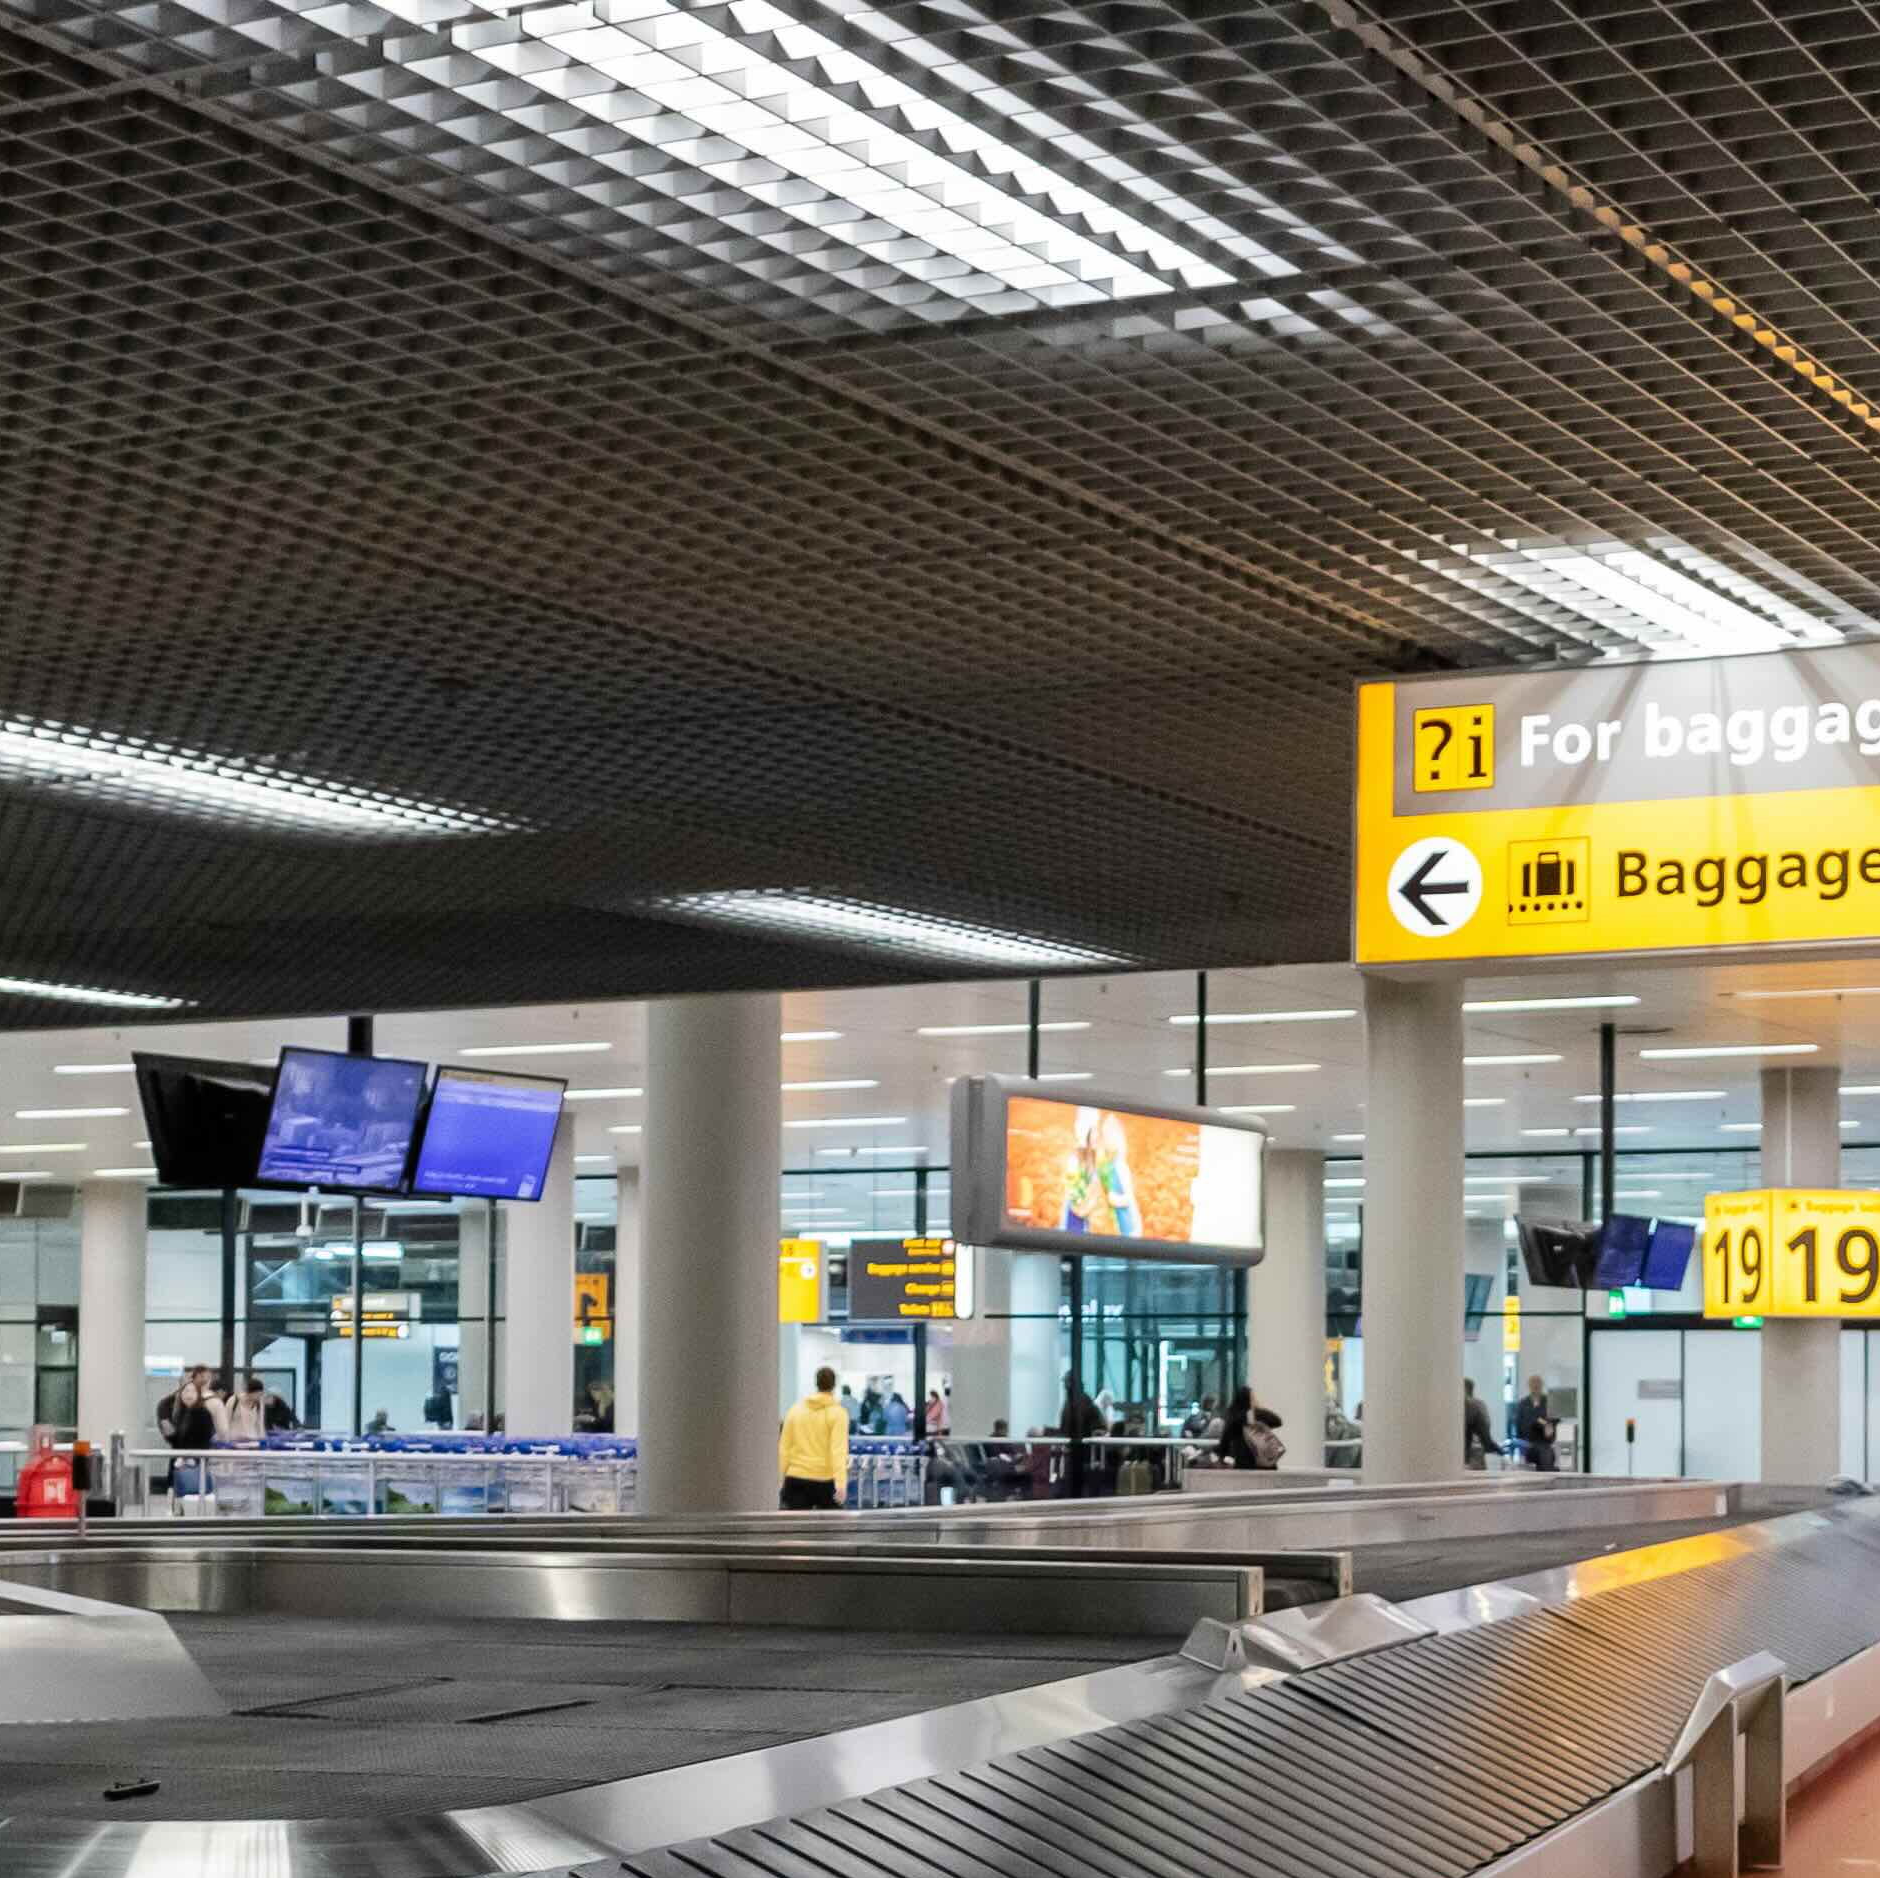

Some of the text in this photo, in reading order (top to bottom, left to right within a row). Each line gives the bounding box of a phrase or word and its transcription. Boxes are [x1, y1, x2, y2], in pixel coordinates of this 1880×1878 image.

[1519, 713, 1621, 769] For
[1714, 1228, 1762, 1304] 19
[1787, 1226, 1880, 1304] 19
